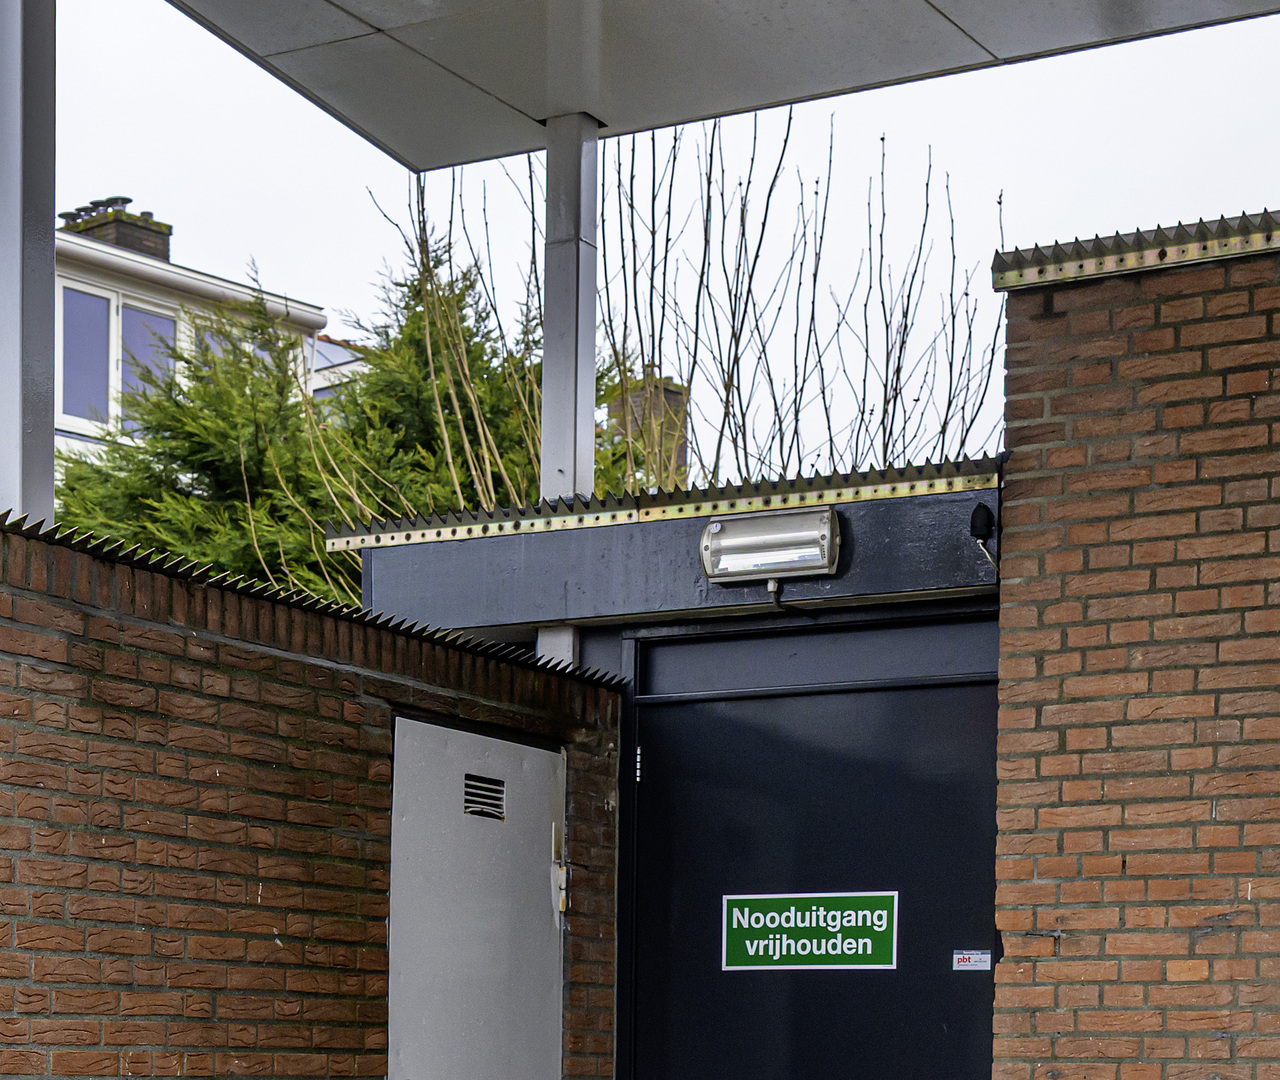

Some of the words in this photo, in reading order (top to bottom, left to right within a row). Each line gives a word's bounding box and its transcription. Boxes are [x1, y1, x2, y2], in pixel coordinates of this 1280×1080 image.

[732, 905, 888, 932] Nooduitgang
[745, 933, 872, 960] vrijhouden
[957, 955, 972, 965] pbt
